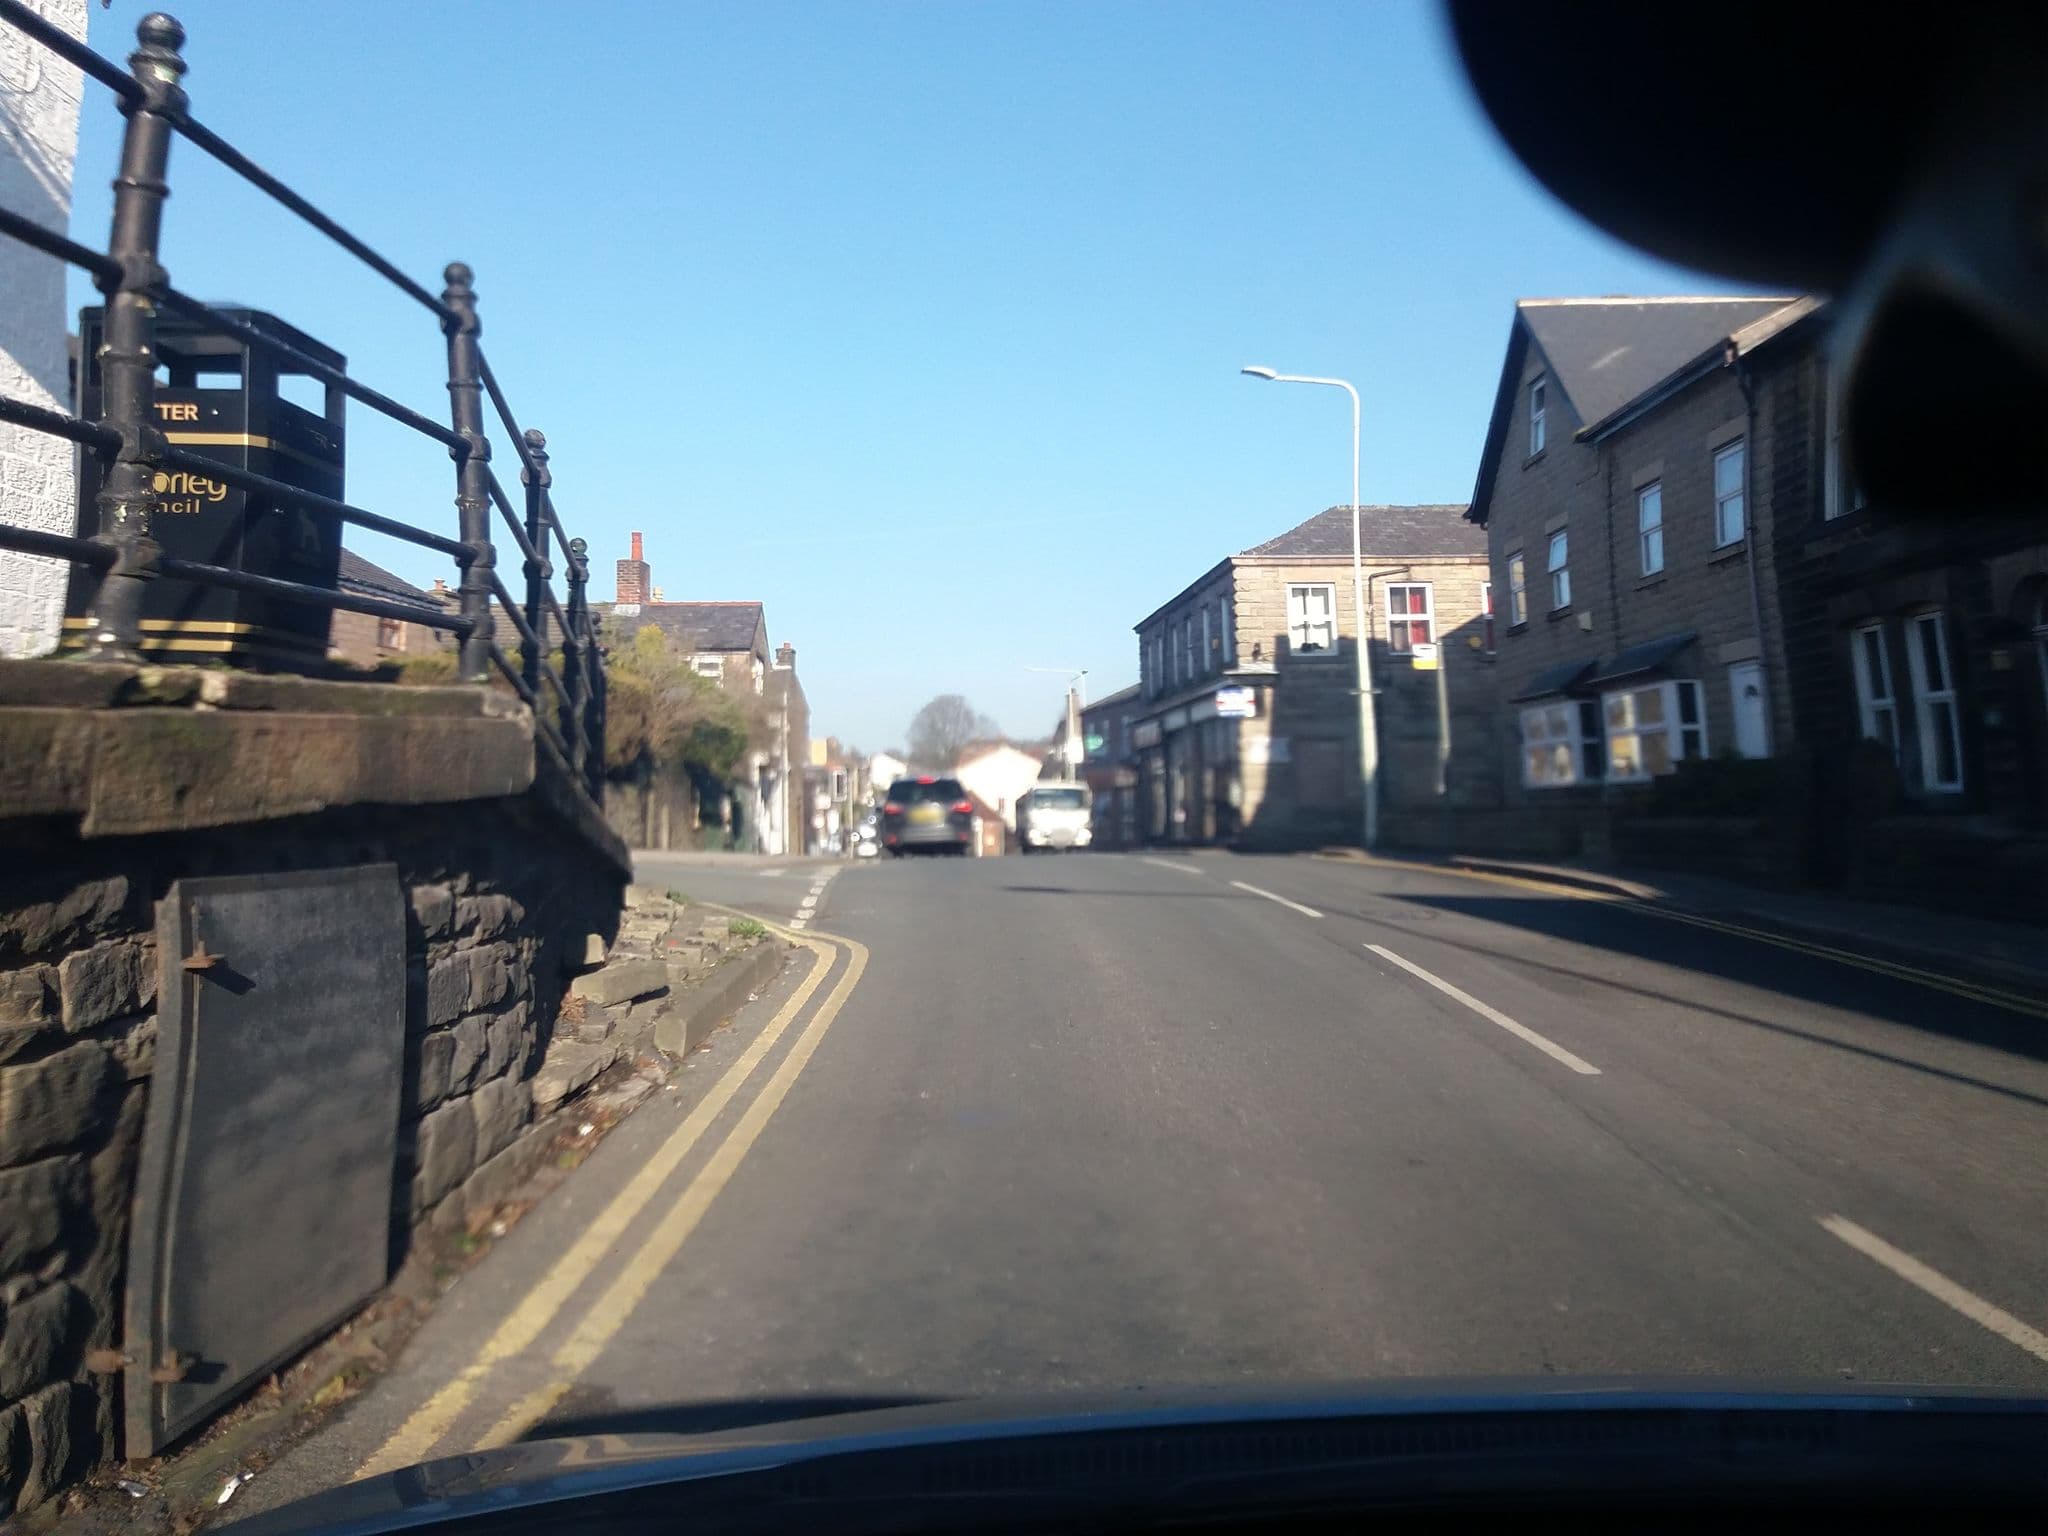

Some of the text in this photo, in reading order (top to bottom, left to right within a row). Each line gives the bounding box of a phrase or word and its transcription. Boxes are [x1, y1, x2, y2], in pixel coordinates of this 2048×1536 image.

[153, 403, 199, 421] TER
[152, 472, 227, 501] orley
[156, 499, 200, 513] ncil
